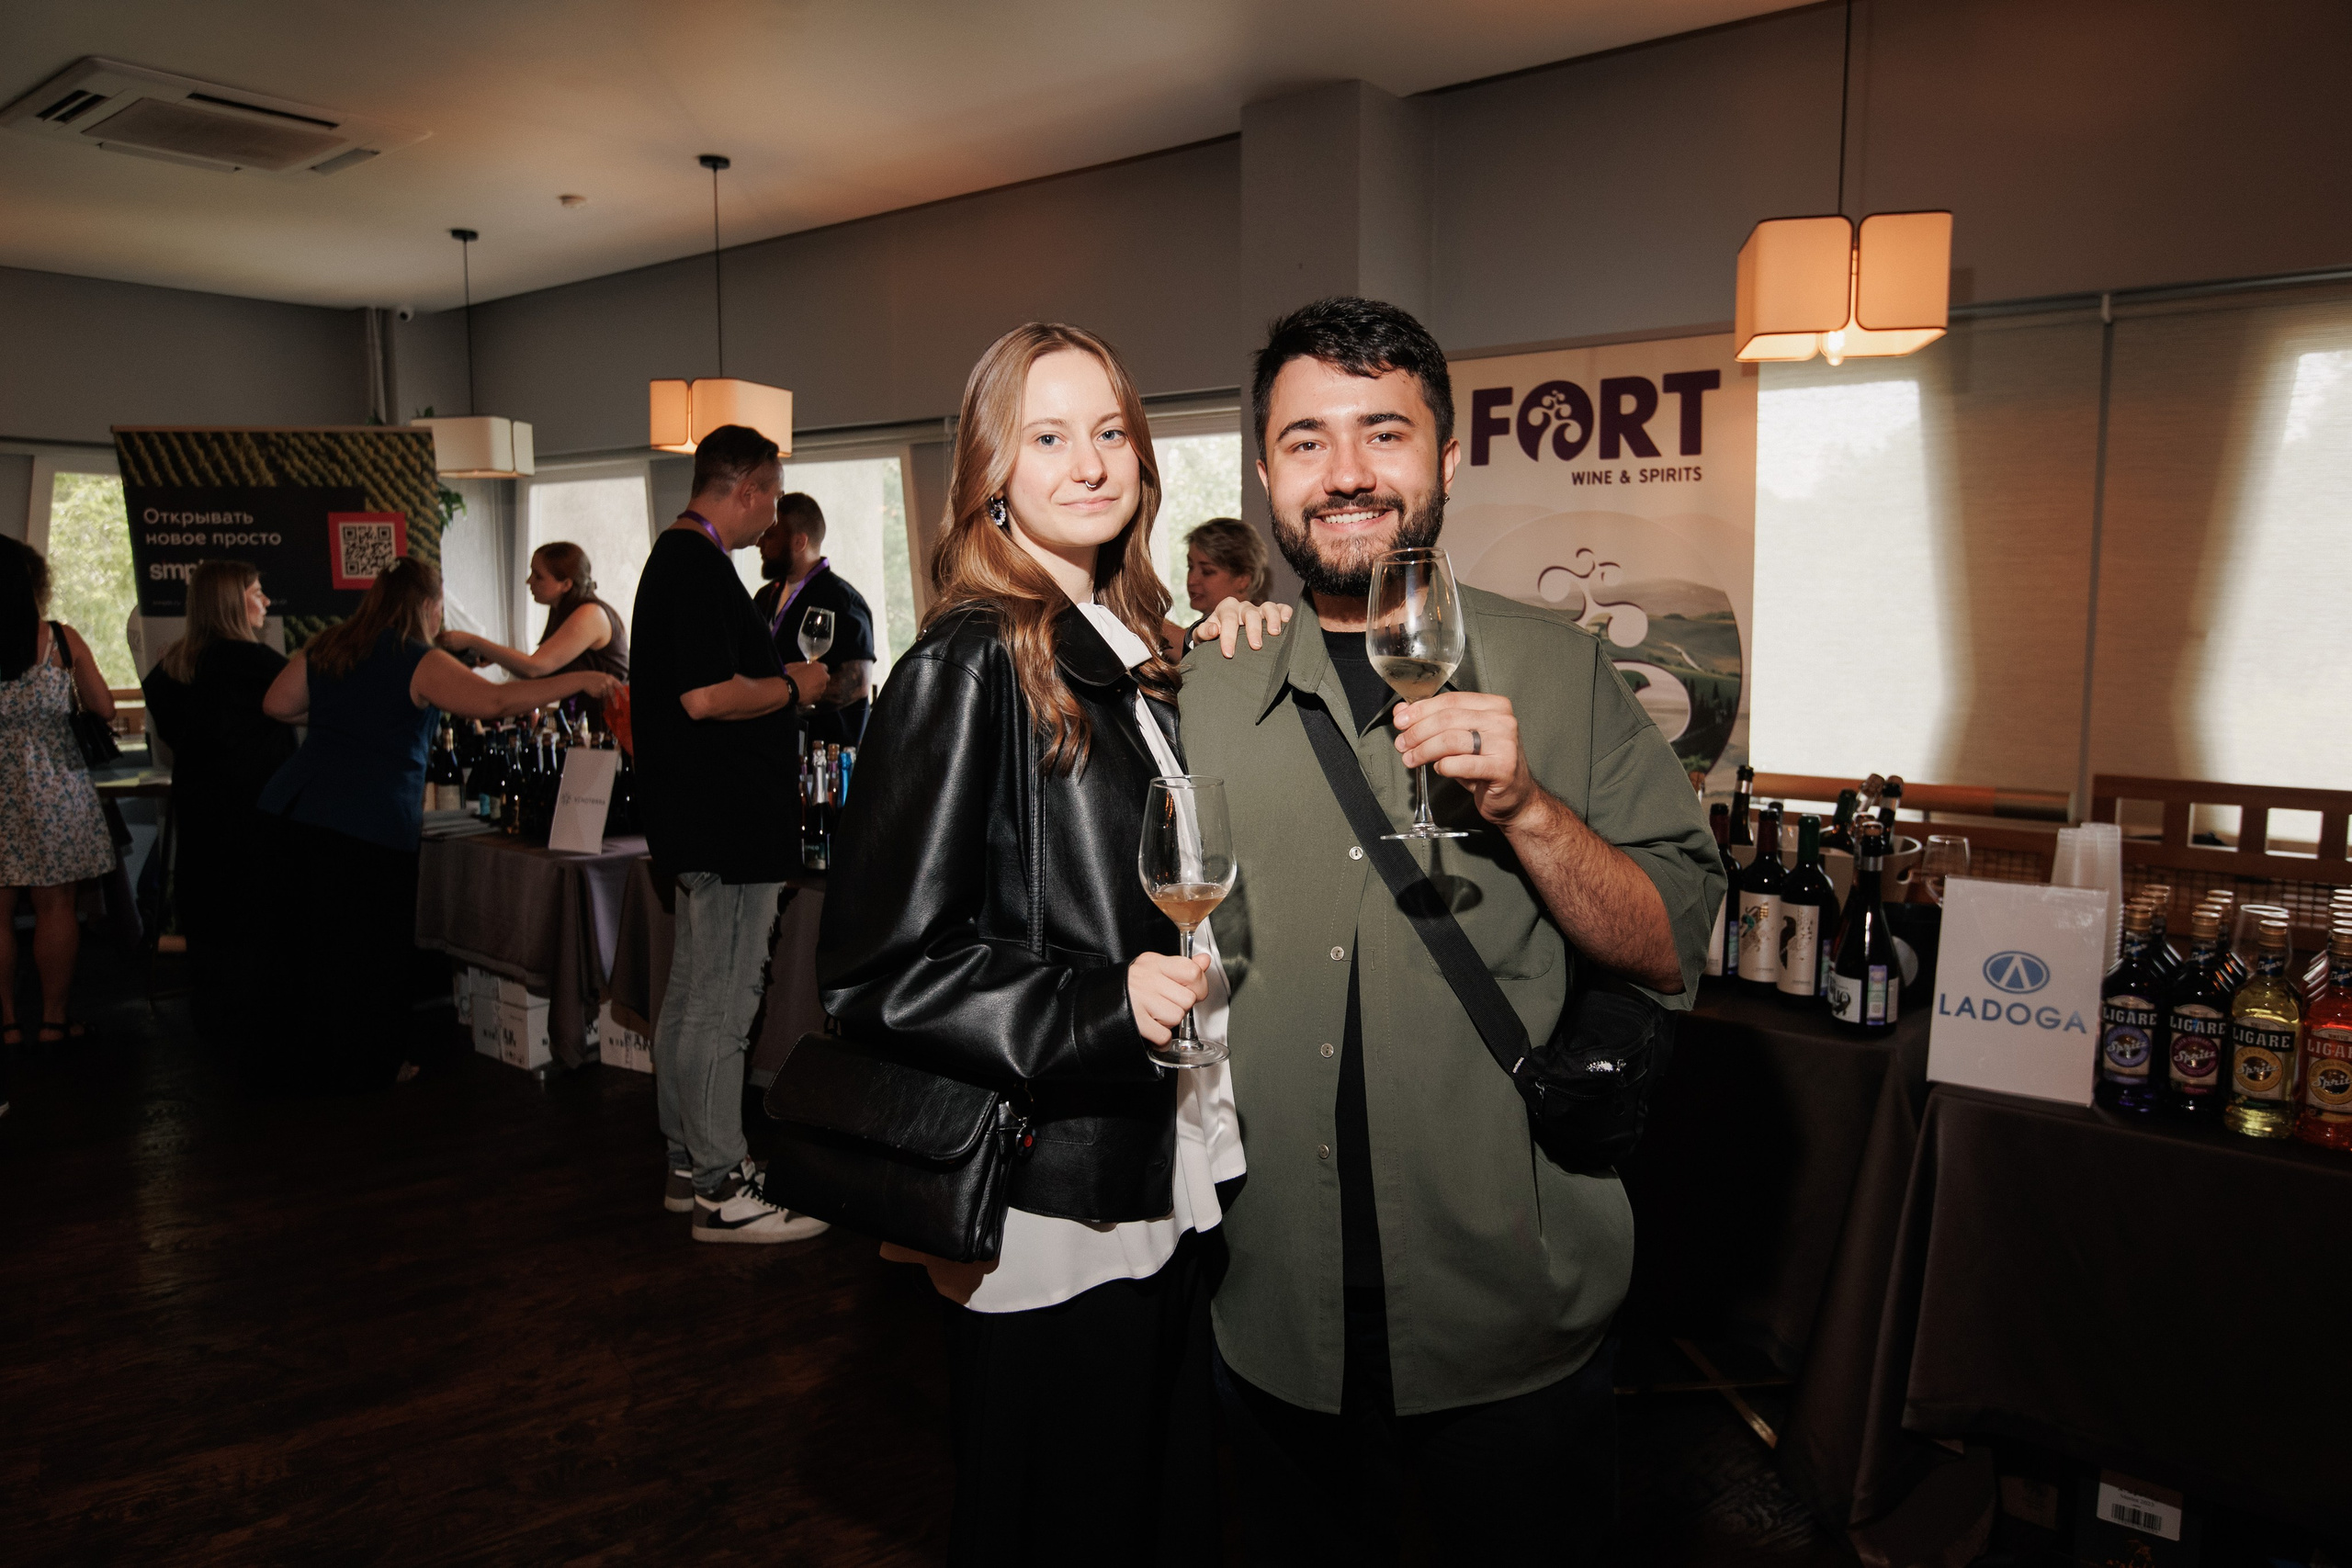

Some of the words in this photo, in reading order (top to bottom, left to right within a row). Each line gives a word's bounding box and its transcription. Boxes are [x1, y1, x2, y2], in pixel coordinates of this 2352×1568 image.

[1470, 369, 1721, 467] FORT
[1571, 468, 1612, 486] WINE
[1620, 469, 1631, 484] &
[1639, 465, 1702, 484] SPIRITS
[143, 507, 254, 527] Открывать
[145, 532, 207, 547] новое
[211, 531, 282, 548] просто
[1938, 992, 2087, 1034] LADOGA
[2103, 1006, 2158, 1025] LIGARE
[2169, 1015, 2227, 1035] LIGARE
[2232, 1027, 2290, 1048] LIGARE
[2173, 1048, 2217, 1064] Spritz
[2312, 1075, 2352, 1090] Sprit
